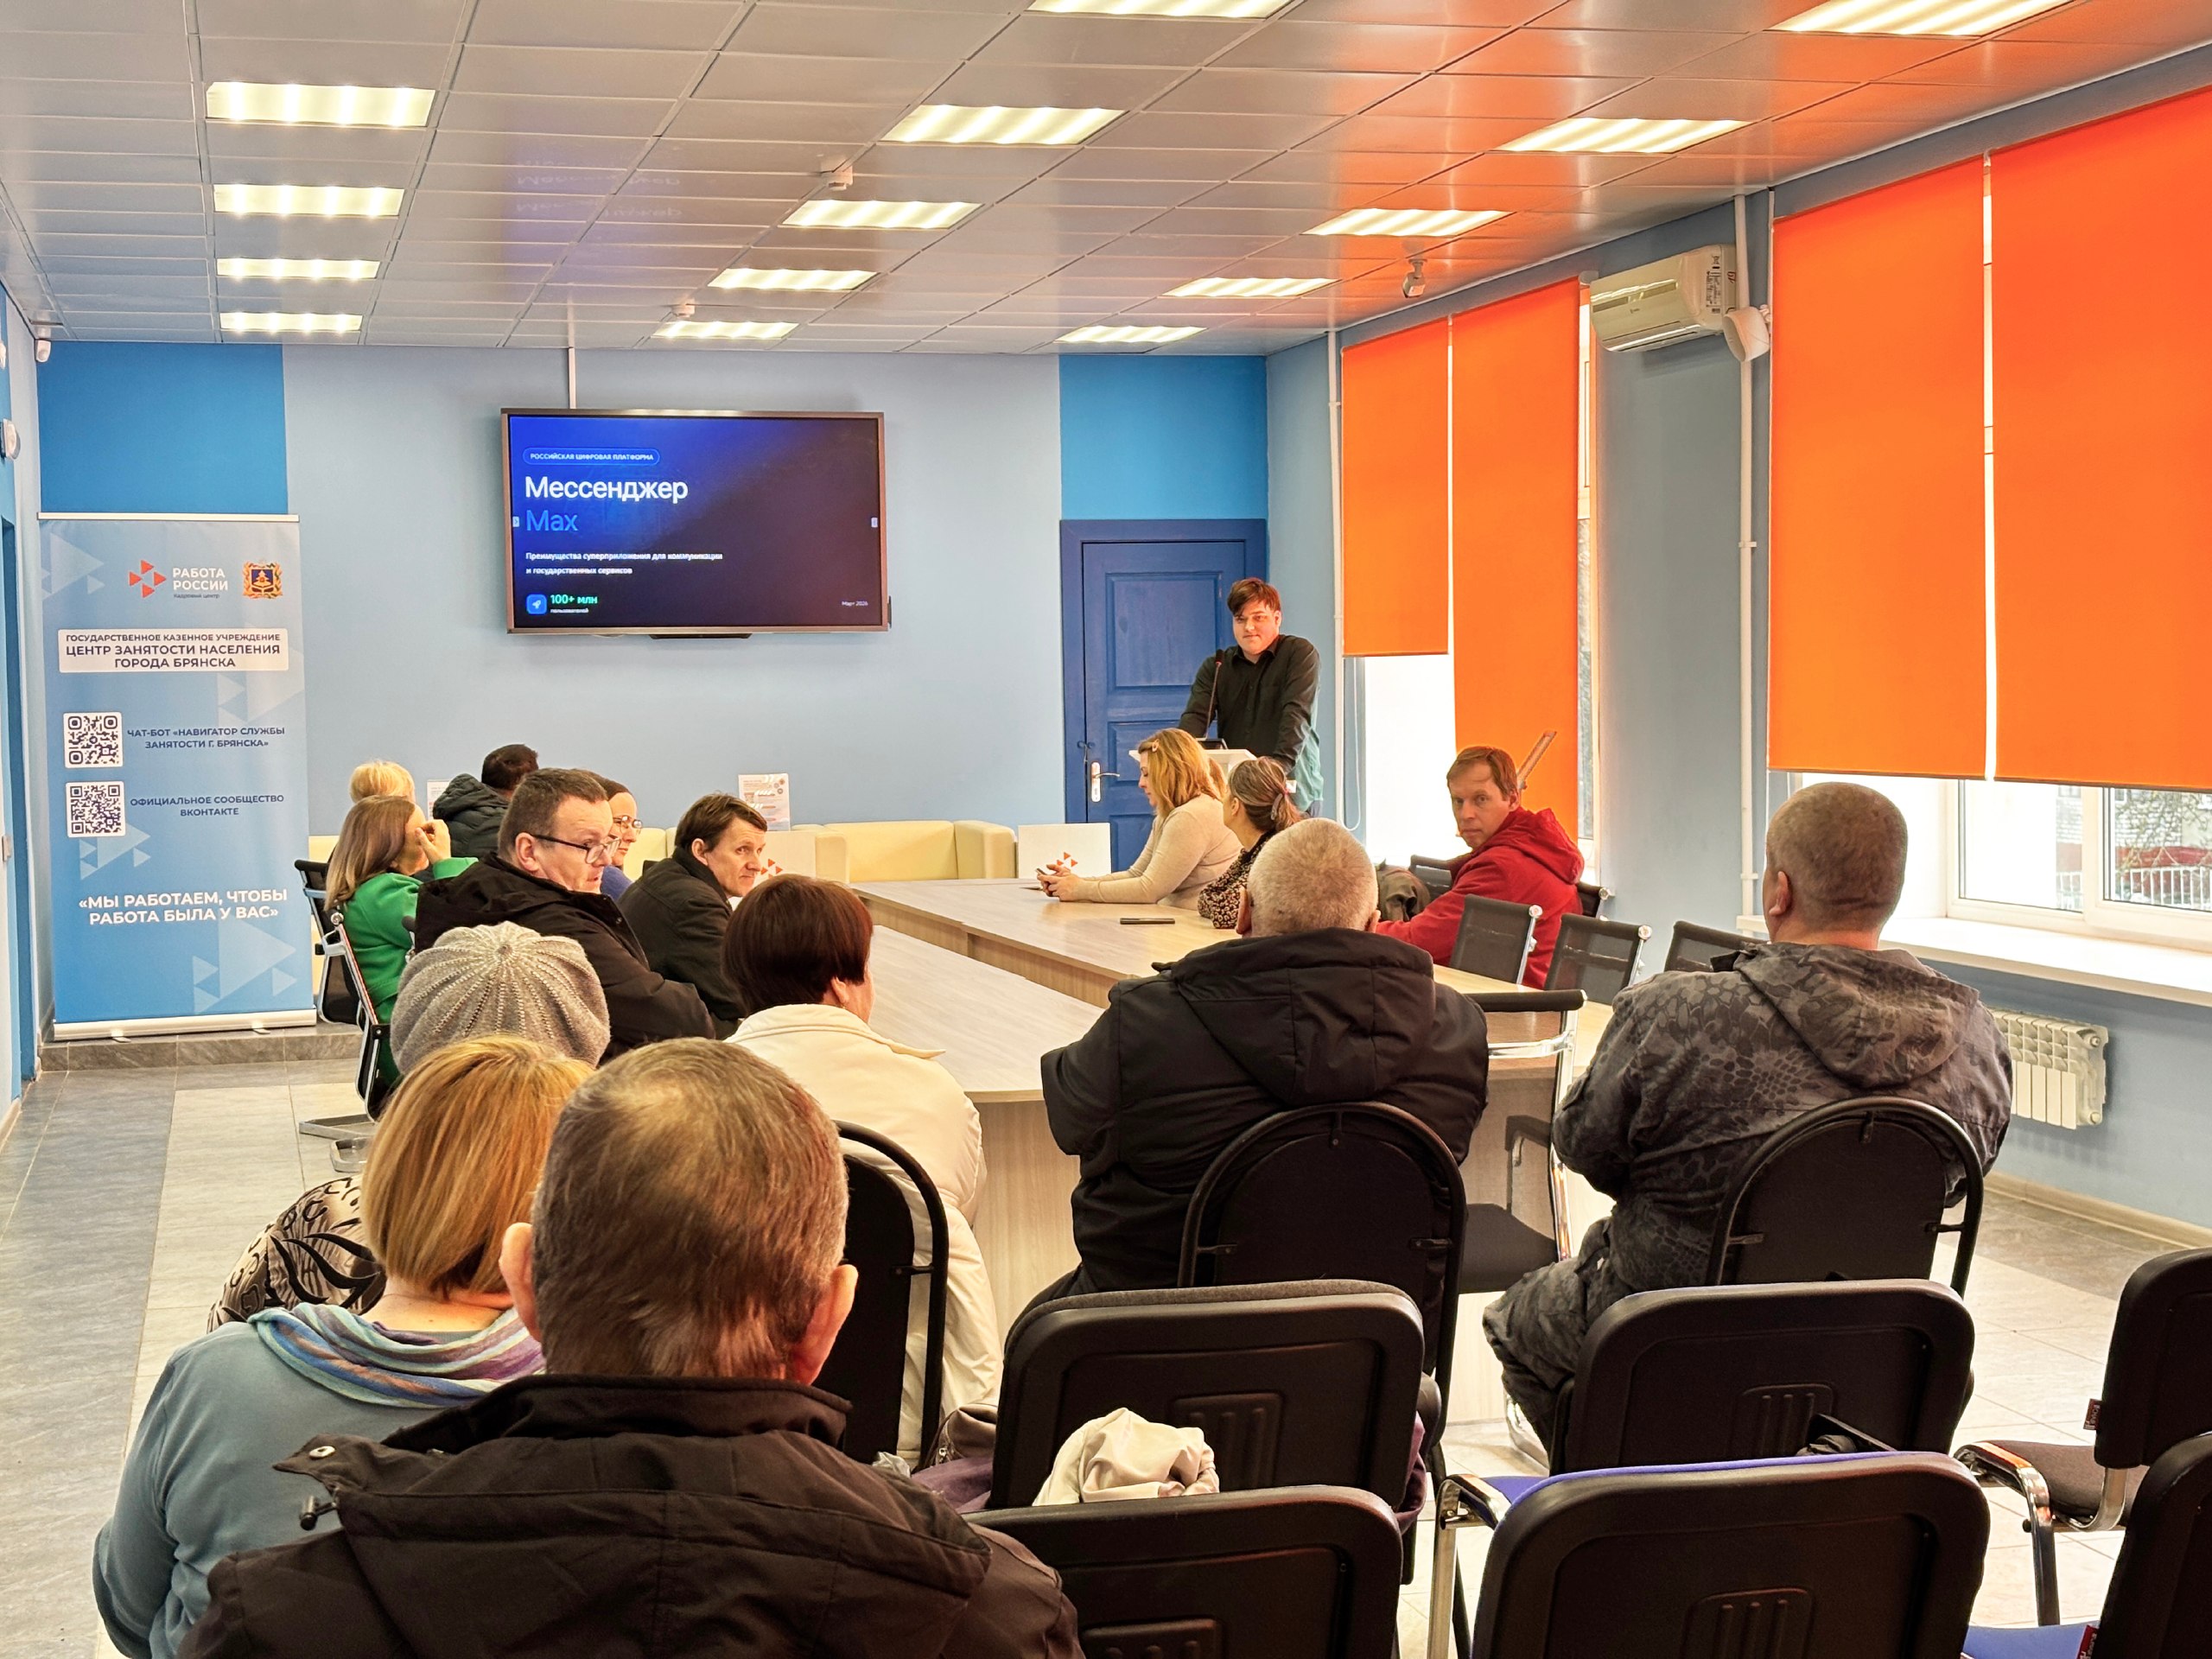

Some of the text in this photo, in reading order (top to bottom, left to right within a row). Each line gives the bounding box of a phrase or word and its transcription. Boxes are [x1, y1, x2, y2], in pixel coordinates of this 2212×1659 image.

[525, 476, 688, 503] Мессенджер
[526, 510, 578, 531] Max
[525, 552, 582, 561] Преимущества
[173, 568, 226, 578] РАБОТА
[173, 580, 228, 591] РОССИИ
[550, 594, 575, 604] 100+
[66, 634, 161, 643] ГОСУДАРСТВЕННОЕ
[216, 634, 280, 642] УЧРЕЖДЕНИЕ
[66, 645, 280, 657] ЦЕНТР ЗАНЯТОСТИ НАСЕЛЕНИЯ
[114, 658, 236, 669] ГОРОДА БРЯНСКА
[127, 727, 285, 737] ЧАТ-БОТ «НАВИГАТОР СЛУЖБЫ
[145, 740, 206, 749] ЗАНЯТОСТИ
[217, 739, 269, 747] БРЯНСКА»
[130, 795, 284, 807] ОФИЦИАЛЬНОЕ СООБЩЕСТВО
[180, 807, 239, 817] ВКОНТАКТЕ
[79, 889, 287, 909] «МЫ РАБОТАЕМ, ЧТОБЫ
[90, 906, 279, 925] РАБОТА БЫЛА У ВАС»
